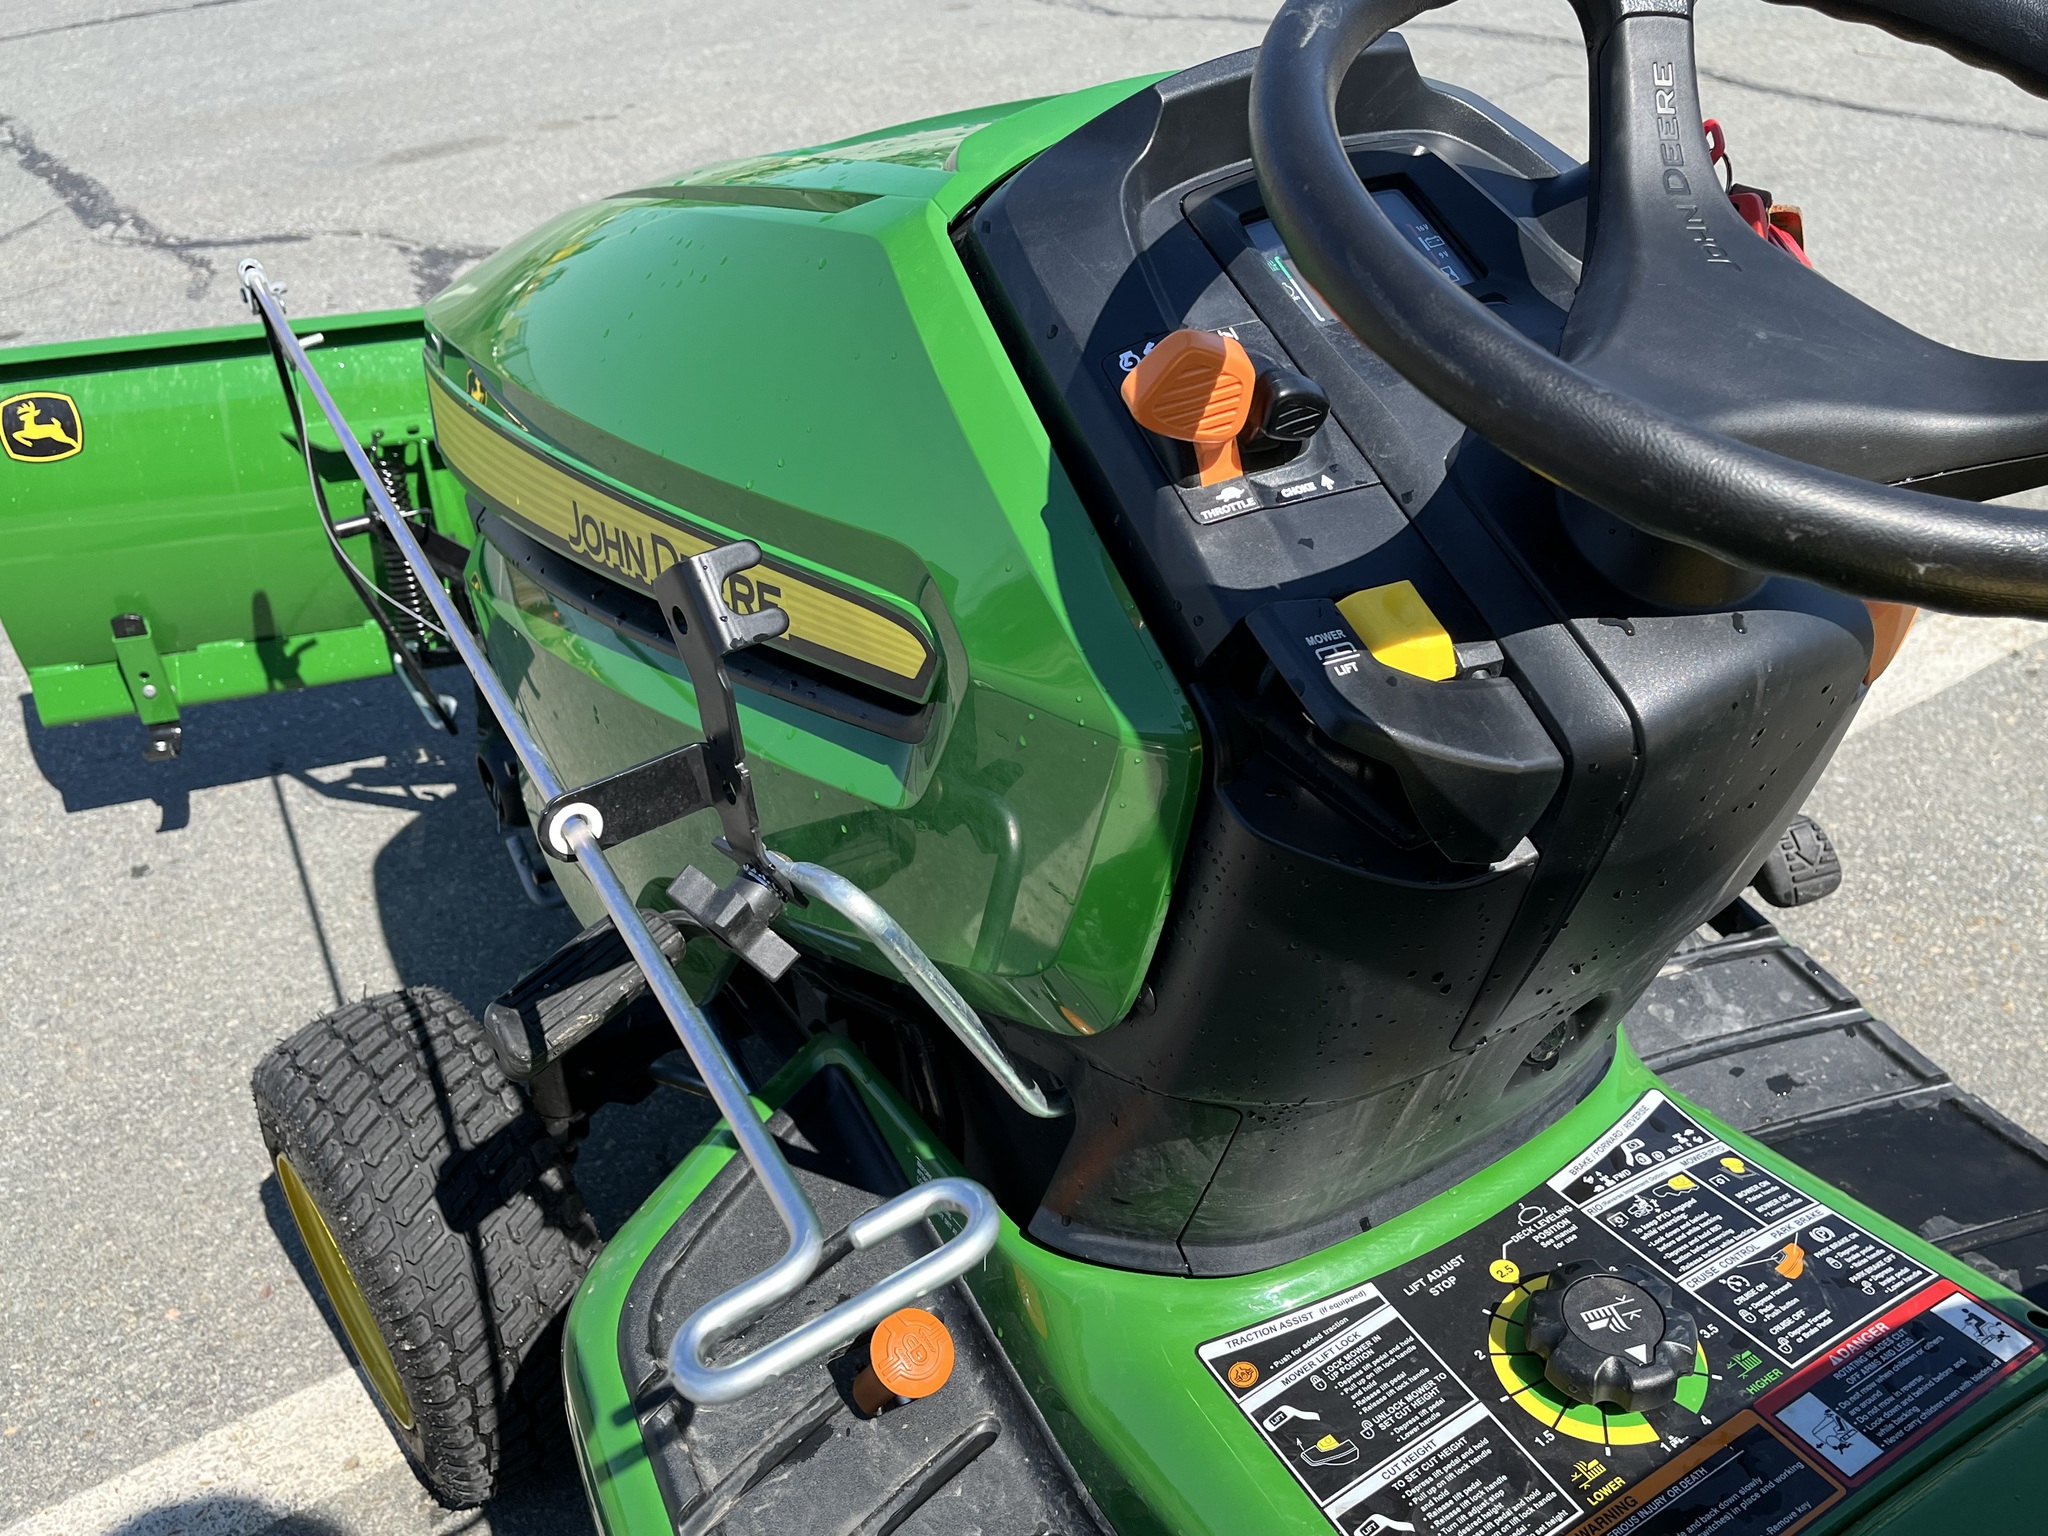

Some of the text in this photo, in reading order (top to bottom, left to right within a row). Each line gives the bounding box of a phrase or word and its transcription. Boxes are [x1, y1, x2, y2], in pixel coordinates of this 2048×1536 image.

[1653, 62, 1691, 195] DEERE
[1280, 482, 1318, 498] CHOKE
[1200, 497, 1256, 520] THROTTLE
[569, 501, 781, 616] JOHN DRE
[1305, 630, 1346, 646] MOWER
[1334, 662, 1358, 676] LIFT
[1569, 1156, 1593, 1176] BRAKE
[1594, 1130, 1624, 1156] FORWARD
[1624, 1105, 1650, 1129] REVERSE
[1612, 1169, 1632, 1182] FWD
[1510, 1205, 1573, 1243] DECK LEVELING
[1587, 1204, 1603, 1215] RIO
[1770, 1210, 1824, 1239] PARK BRAKE
[1532, 1218, 1571, 1243] POSITION
[1540, 1224, 1578, 1248] See manual
[1553, 1234, 1578, 1249] for use
[1403, 1254, 1465, 1296] LIFT ADJUST
[1496, 1265, 1514, 1278] 2.5
[1686, 1244, 1760, 1288] CRUISE CONTROL
[1429, 1276, 1456, 1296] STOP
[1225, 1290, 1367, 1349] TRACTION ASSIST (If equipped)
[1700, 1324, 1719, 1340] 3.5
[1769, 1309, 1806, 1335] CRUISE OFF
[1273, 1317, 1349, 1368] Push for added traction
[1322, 1334, 1382, 1375] LOCK MOWER IN
[1474, 1350, 1486, 1360] 2
[1833, 1328, 1907, 1380] ROTATING BLADES CUT
[1836, 1322, 1890, 1358] DANGER
[1281, 1332, 1361, 1386] MOWER LIFT LOCK
[1328, 1348, 1375, 1381] UP POSITION
[1337, 1335, 1414, 1388] Depress lift pedal and hold
[1343, 1345, 1417, 1394] Pull up on lift lock handle
[1846, 1337, 1914, 1384] OFF ARMS AND LEGS
[1351, 1380, 1377, 1400] and hold
[1356, 1371, 1407, 1407] Release lift pedal
[1362, 1368, 1430, 1413] Release lift lock handle
[1372, 1372, 1447, 1424] UNLOCK MOWER TO
[1746, 1369, 1783, 1395] HIGHER
[1271, 1413, 1284, 1424] LIFT
[1378, 1386, 1440, 1430] SET CUT HEIGHT
[1393, 1397, 1445, 1434] Depress lift pedal
[1400, 1412, 1441, 1440] Lower handle
[1700, 1415, 1712, 1425] 4
[1535, 1430, 1555, 1446] 1.5
[1660, 1442, 1671, 1452] 1
[1382, 1439, 1437, 1480] CUT HEIGHT
[1391, 1436, 1467, 1490] TO SET CUT HEIGHT
[1405, 1437, 1489, 1497] Depress lift pedal and hold
[1412, 1449, 1492, 1505] Pull up on lift lock handle
[1426, 1479, 1482, 1520] Release lift pedal
[1587, 1477, 1626, 1506] LOWER
[1637, 1495, 1667, 1519] INJURY
[1667, 1486, 1682, 1497] OR
[1679, 1467, 1708, 1489] DEATH
[1730, 1507, 1741, 1515] in
[1740, 1493, 1761, 1510] place
[1760, 1480, 1775, 1494] and
[1774, 1462, 1805, 1483] working
[1440, 1490, 1505, 1534] Turn lift adjust stop
[1766, 1501, 1812, 1535] Remove key
